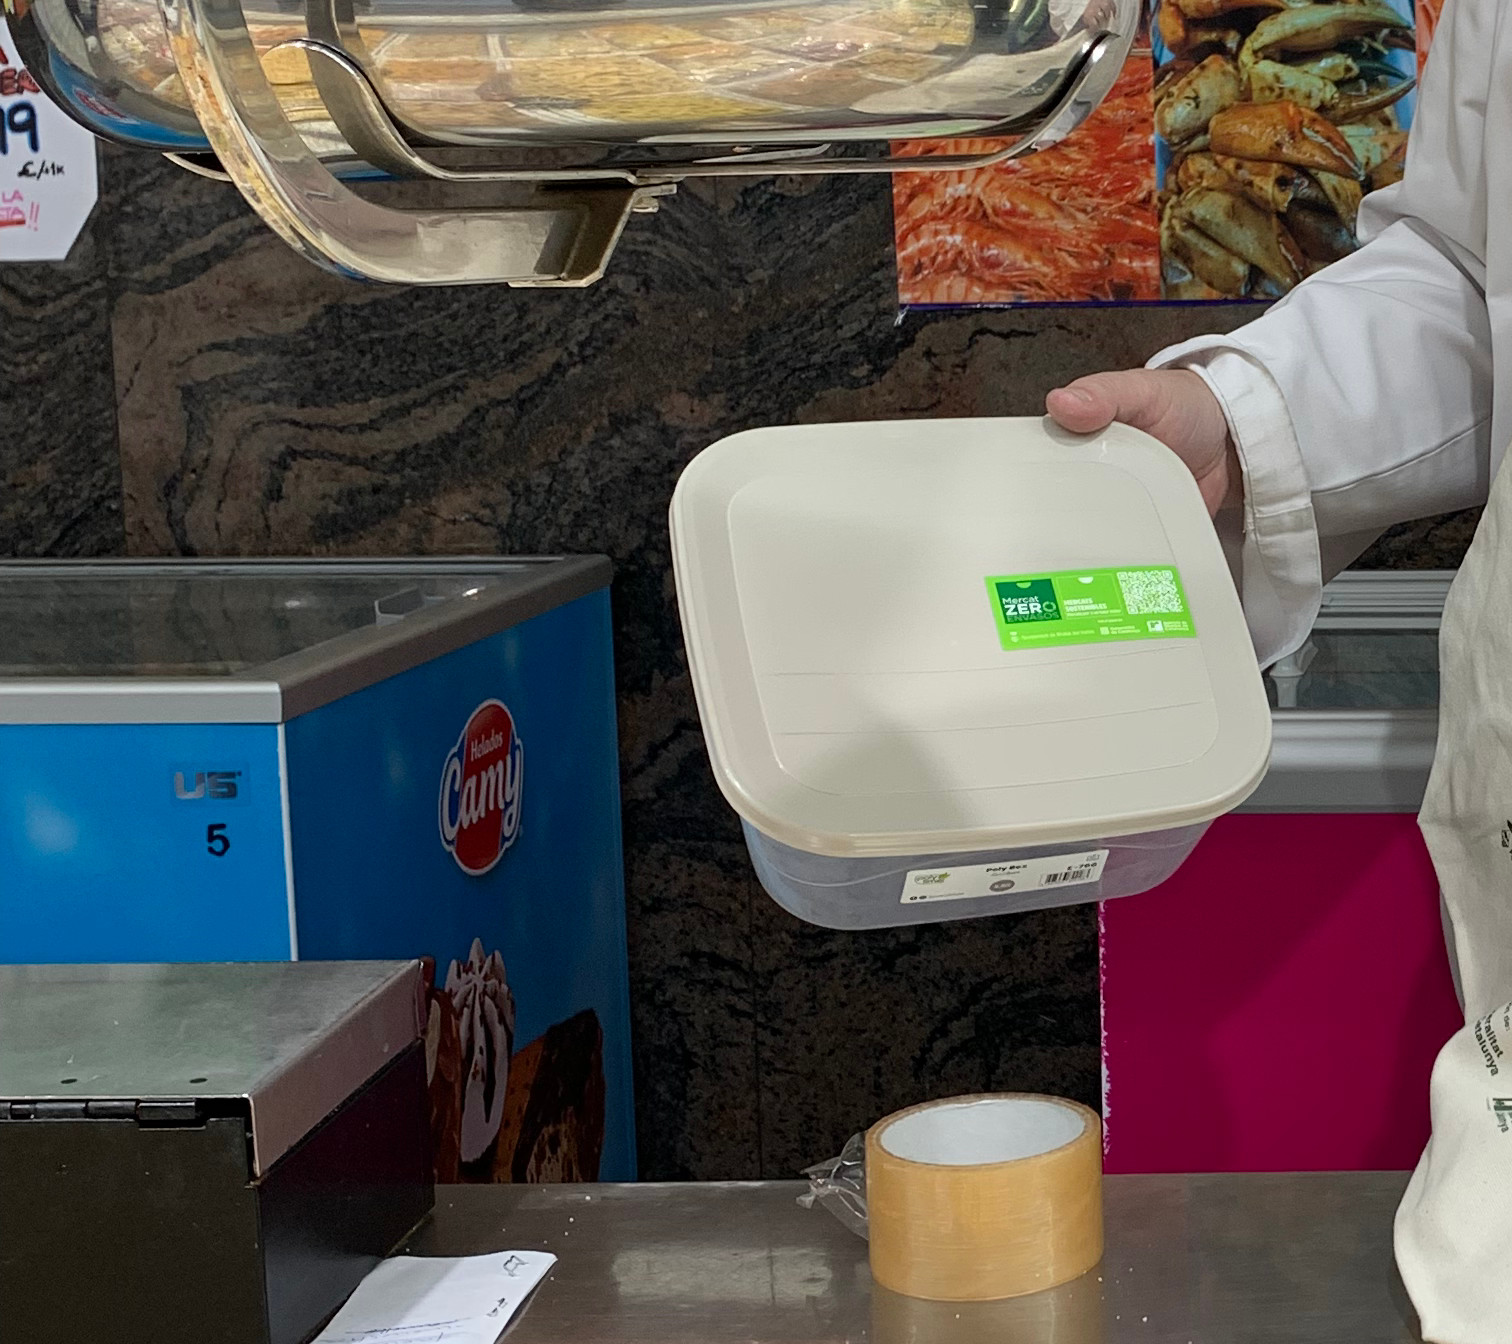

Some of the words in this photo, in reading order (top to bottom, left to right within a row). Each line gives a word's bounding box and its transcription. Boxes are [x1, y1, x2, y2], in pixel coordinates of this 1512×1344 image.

[1002, 595, 1040, 605] Mercat
[470, 729, 504, 763] Helados
[441, 744, 521, 843] Camy
[206, 822, 231, 857] 5
